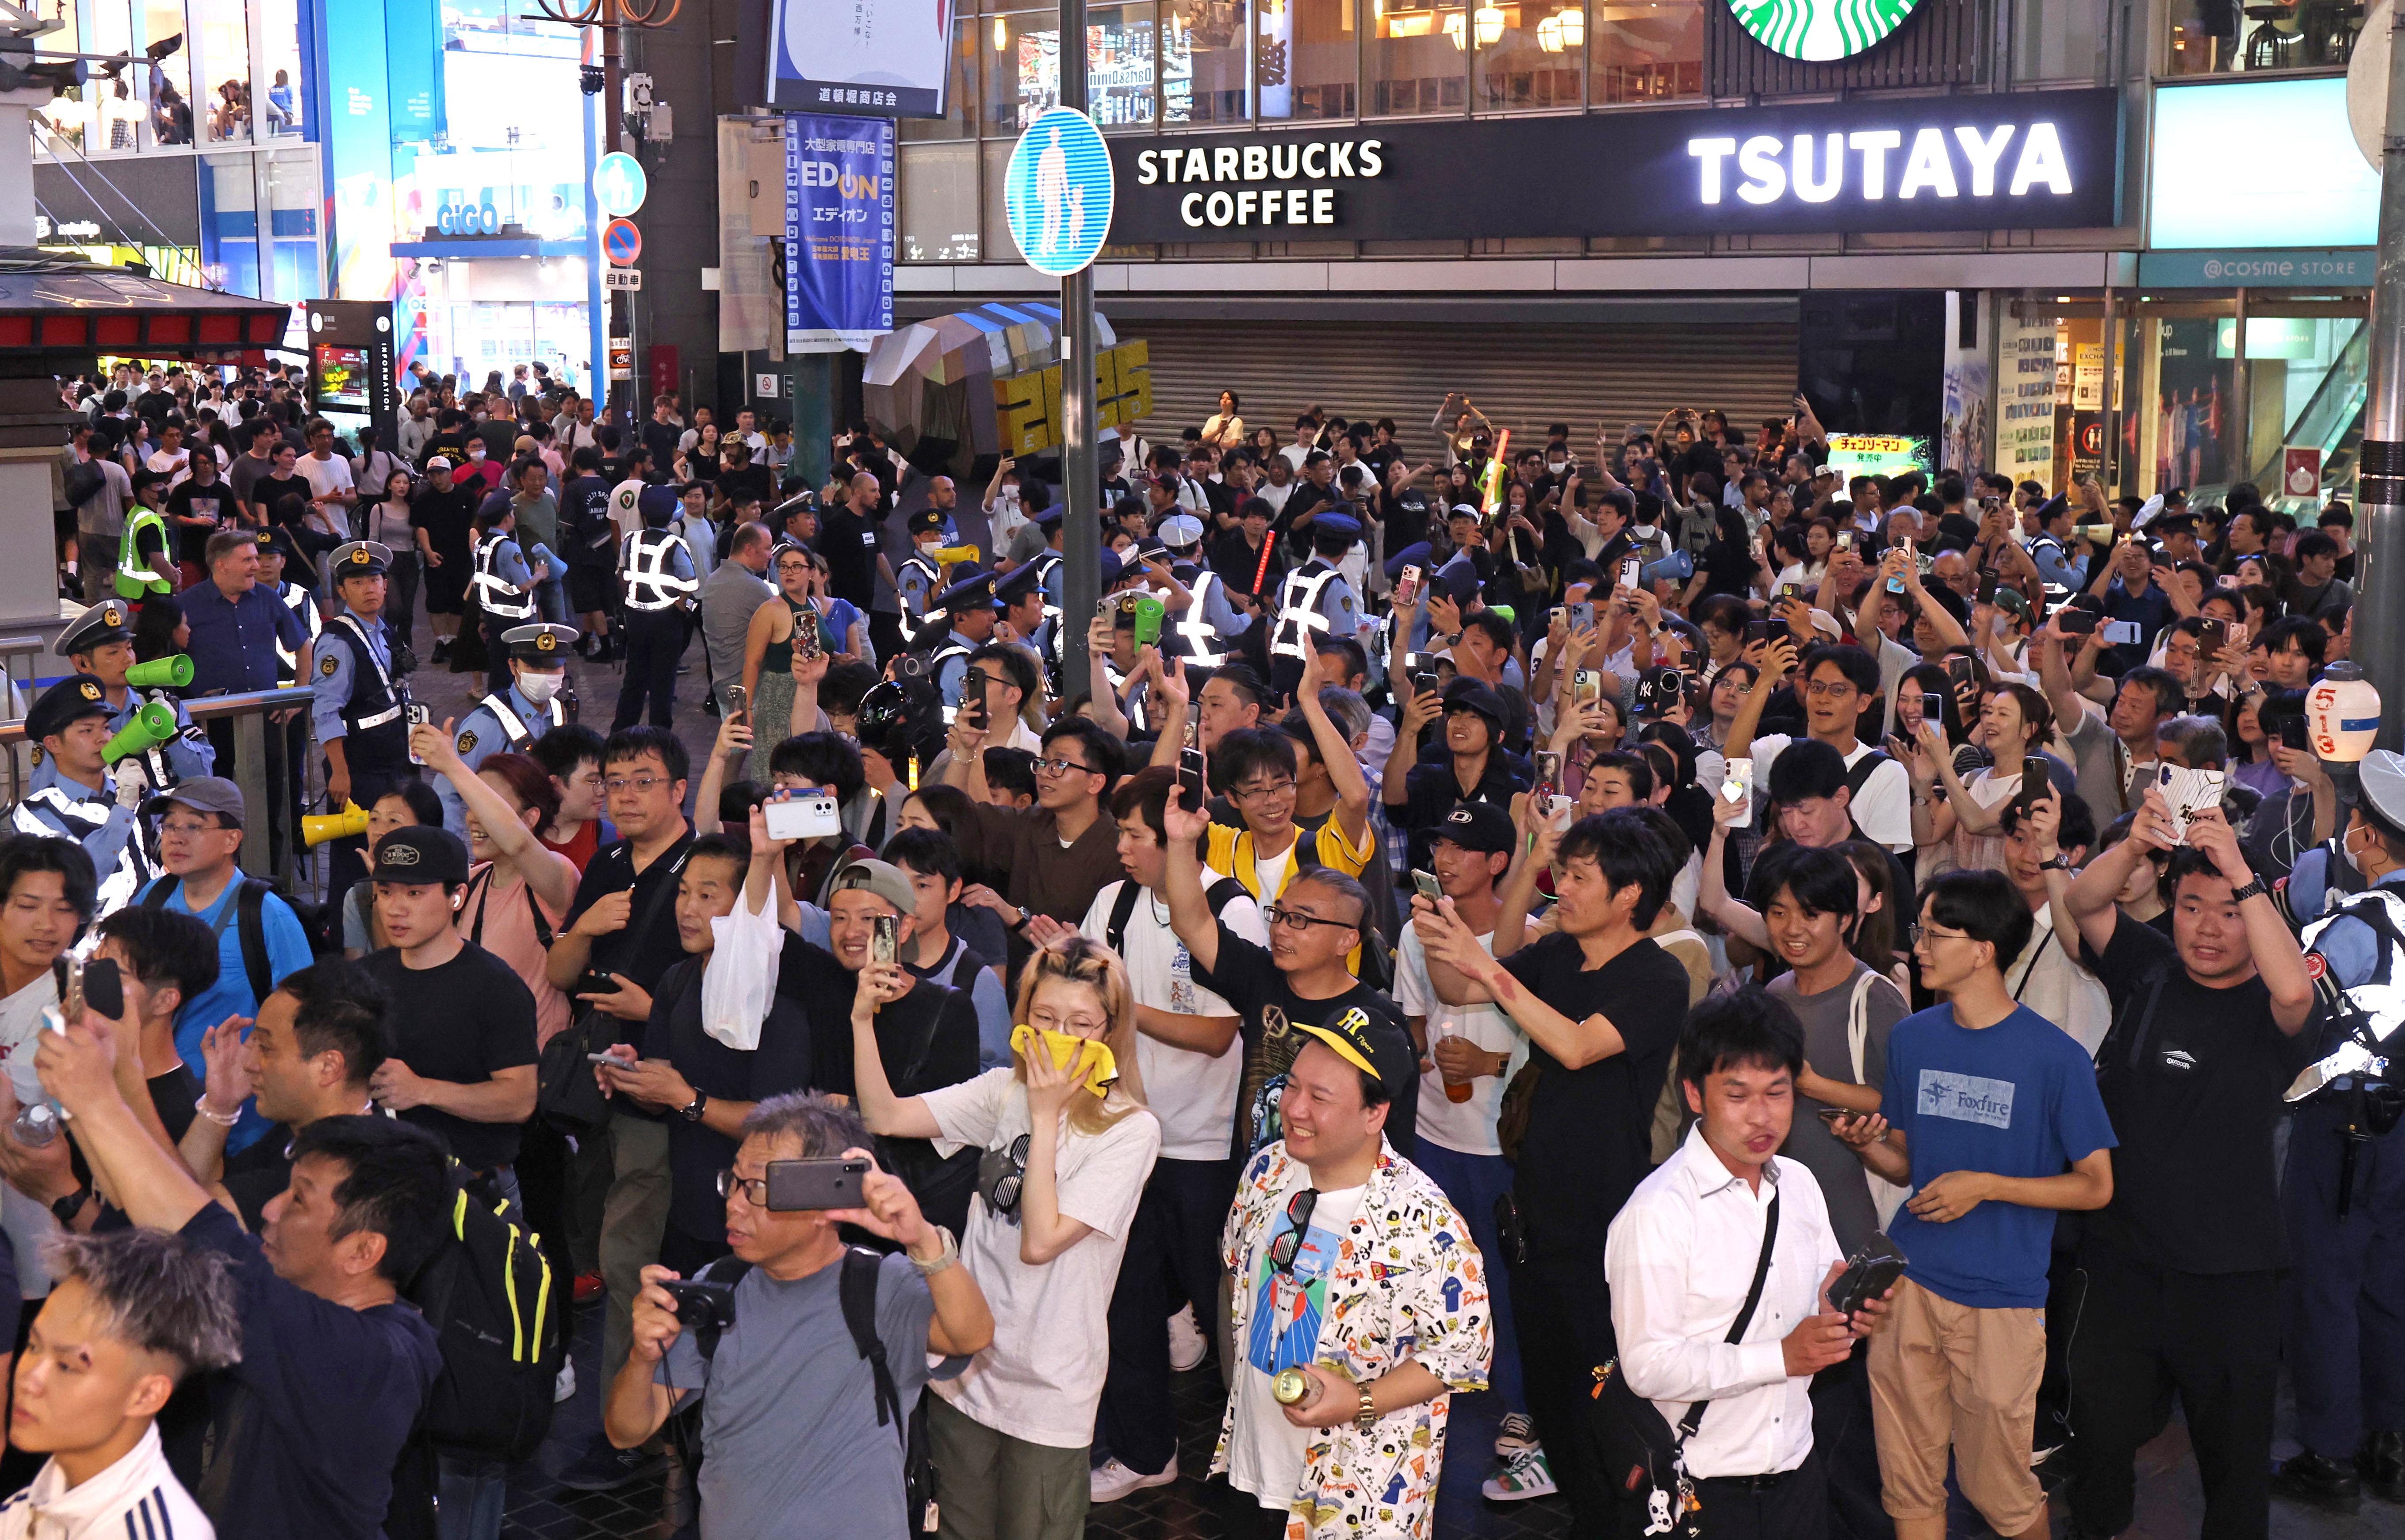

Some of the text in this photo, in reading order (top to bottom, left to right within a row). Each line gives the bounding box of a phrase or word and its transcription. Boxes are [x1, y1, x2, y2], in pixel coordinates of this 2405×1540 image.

[819, 87, 897, 107] 道頓堀商店会
[1137, 139, 1383, 185] STARBUCKS
[1688, 123, 2073, 205] TSUTAYA
[802, 161, 878, 200] EDION
[812, 207, 868, 222] エディオン
[1180, 188, 1334, 228] COFFEE
[437, 203, 498, 236] GiGO
[606, 273, 639, 286] 自動車
[2203, 260, 2356, 279] @cosme STORE
[381, 343, 390, 411] INFORMATION
[1841, 438, 1900, 452] チェンソーマン
[1857, 453, 1882, 463] 発売中
[1356, 1034, 1375, 1054] Tigers
[2166, 1057, 2191, 1070] OUTDOOR
[1957, 1091, 2010, 1116] Foxfire
